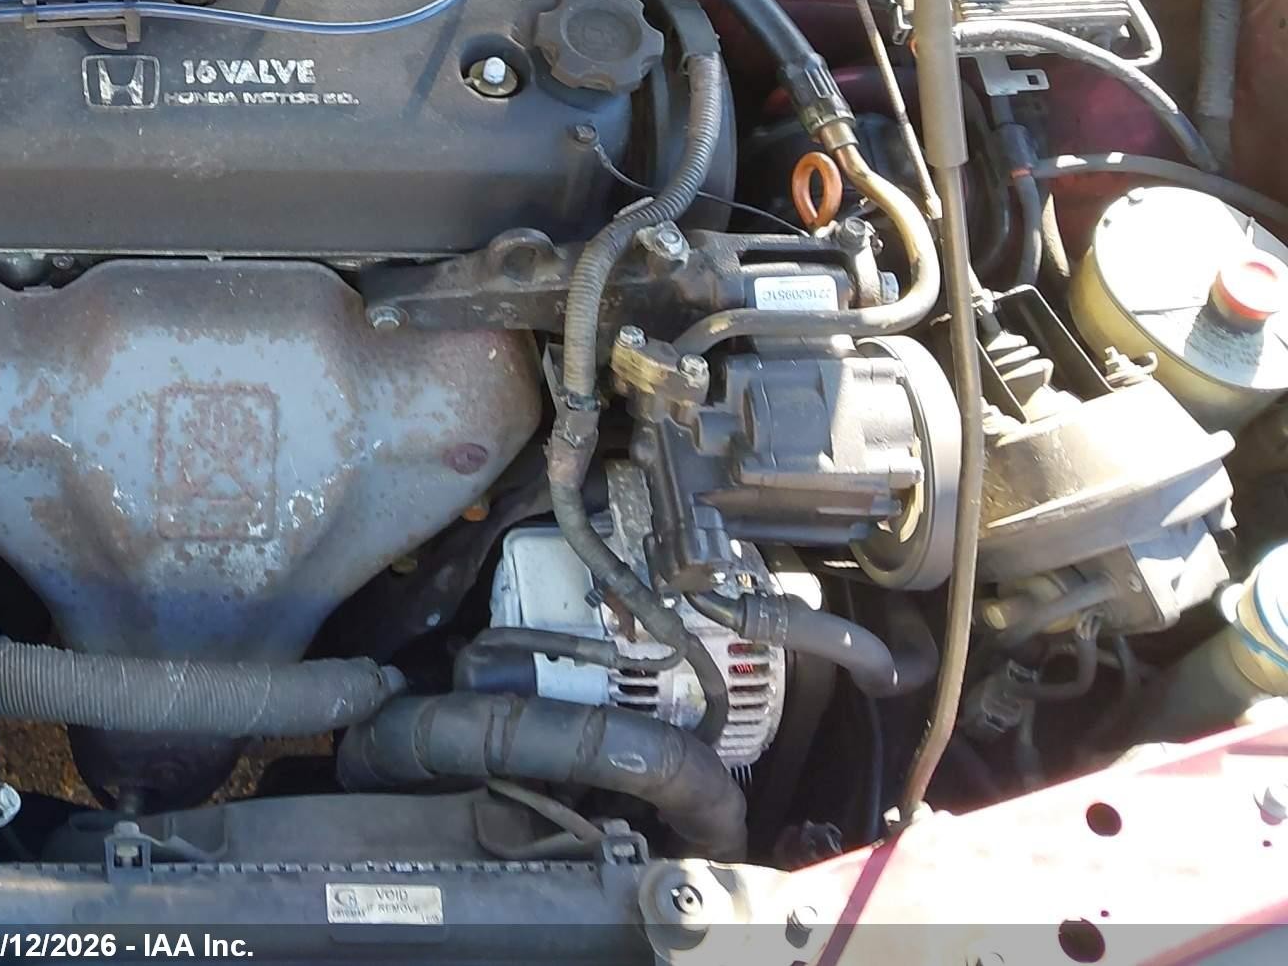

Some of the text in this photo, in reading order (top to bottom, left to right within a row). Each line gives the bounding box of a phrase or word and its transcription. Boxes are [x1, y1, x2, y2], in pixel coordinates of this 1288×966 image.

[164, 92, 239, 106] HONDA
[244, 92, 320, 106] MOTOR
[375, 888, 409, 902] VOID
